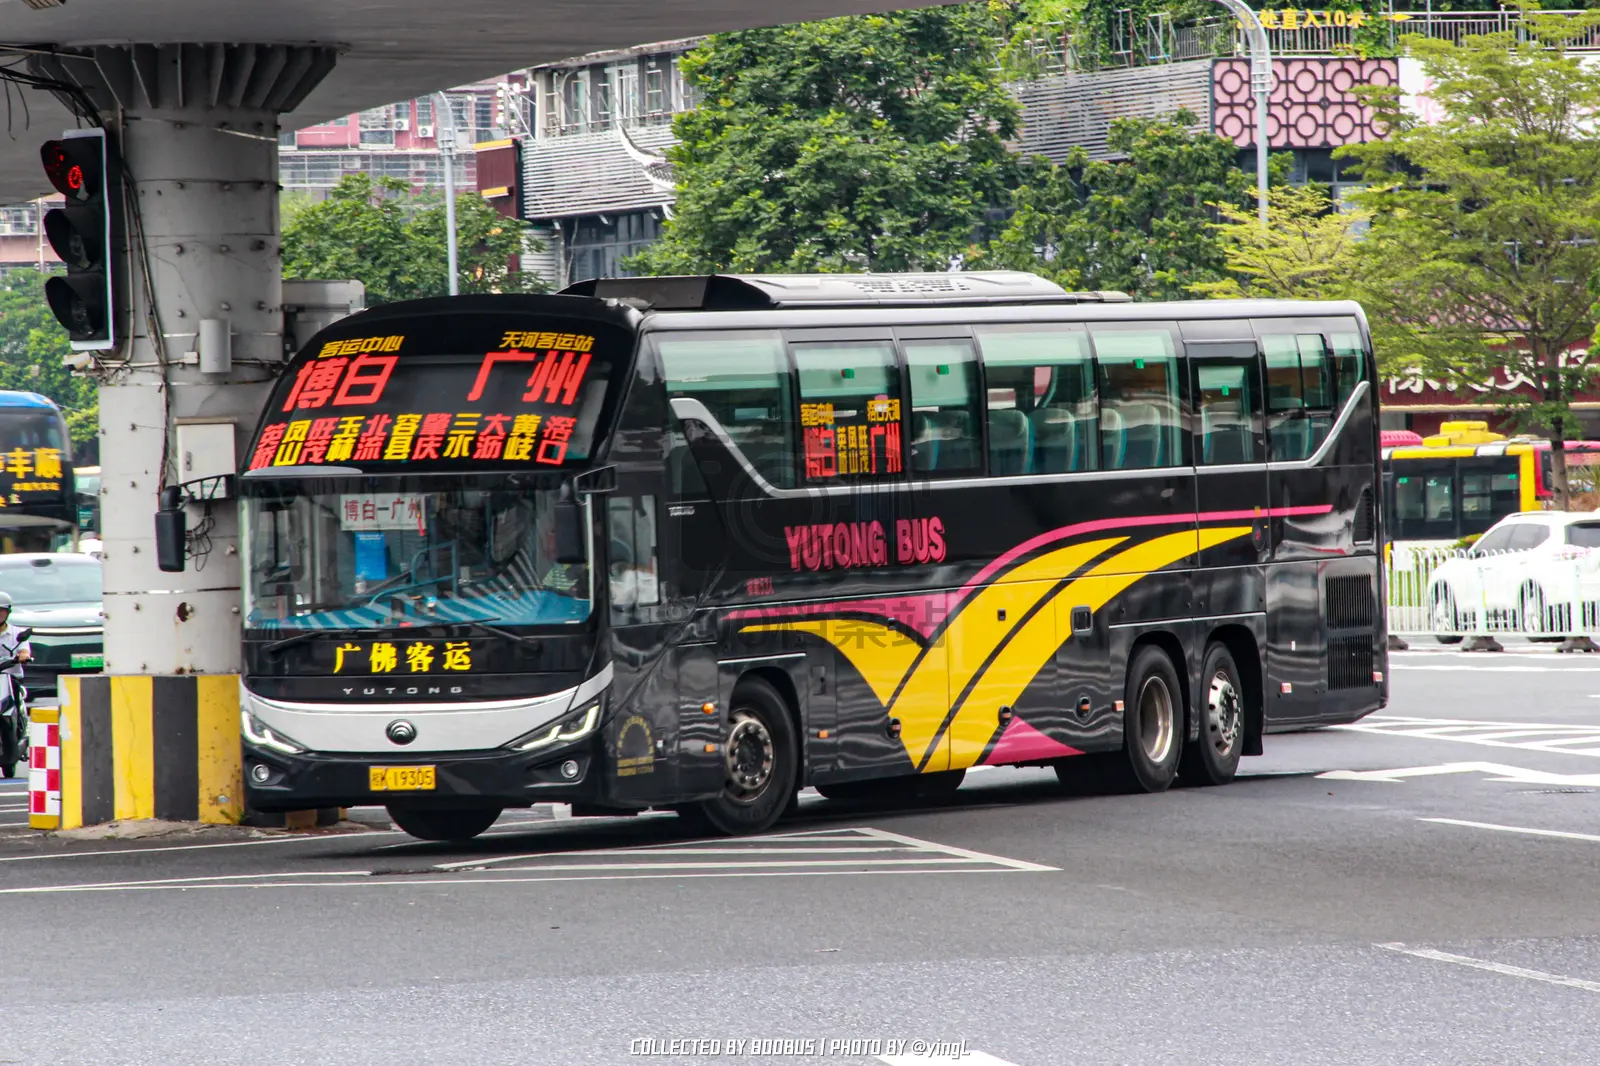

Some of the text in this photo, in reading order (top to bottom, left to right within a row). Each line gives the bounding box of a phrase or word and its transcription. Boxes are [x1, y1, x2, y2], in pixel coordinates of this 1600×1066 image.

[318, 336, 404, 358] 客运中心
[499, 331, 595, 353] 天河客运站
[282, 354, 399, 412] 博白
[467, 350, 592, 405] 广州
[784, 516, 946, 572] YUTONG BUS
[333, 642, 473, 674] 广佛客运
[343, 686, 464, 695] YUTONG
